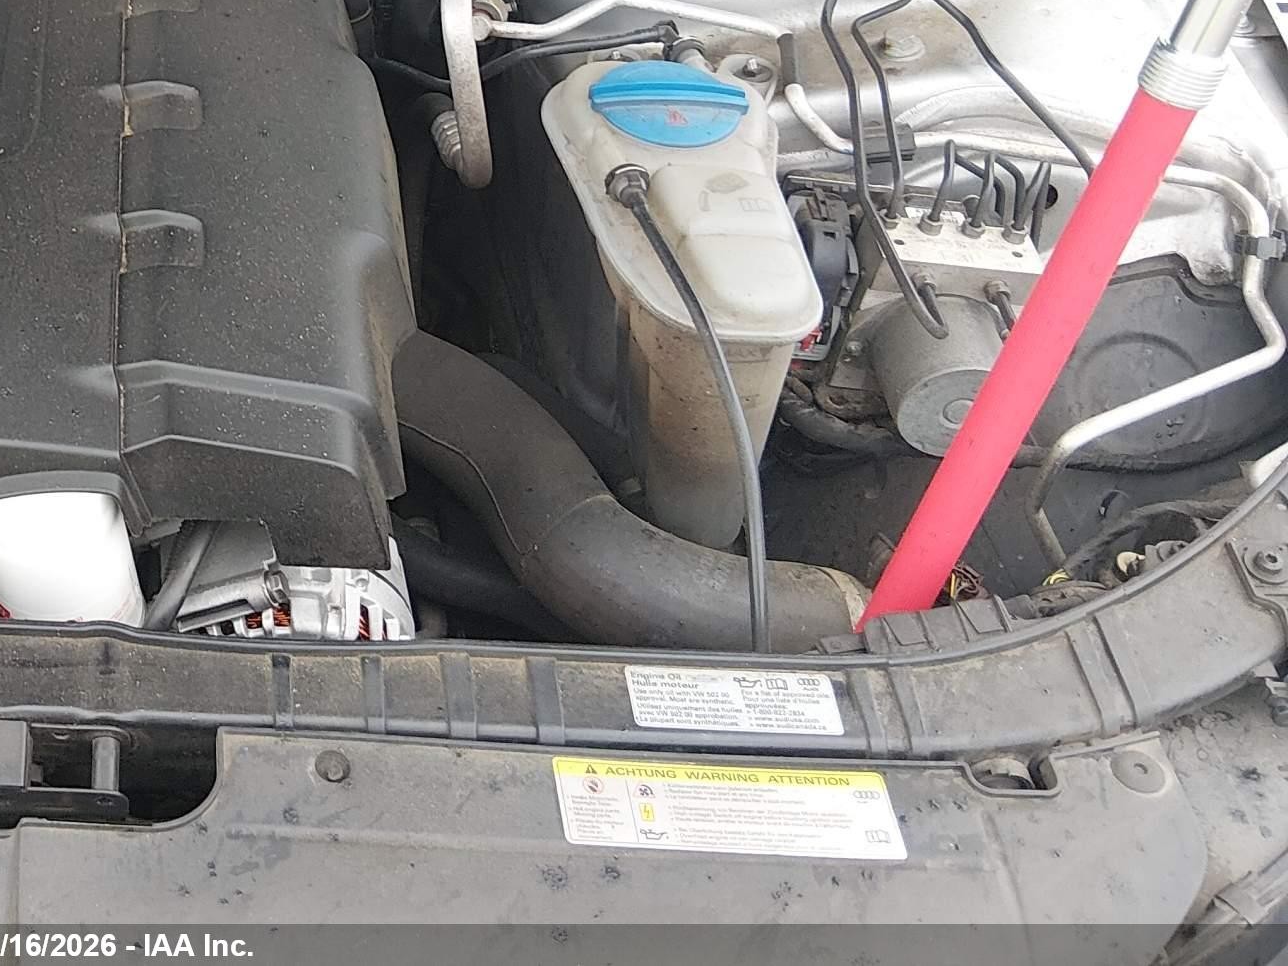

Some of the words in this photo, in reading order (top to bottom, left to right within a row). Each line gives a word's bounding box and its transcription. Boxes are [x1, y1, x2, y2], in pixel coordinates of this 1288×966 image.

[630, 671, 664, 681] Engine
[661, 681, 700, 689] moteur
[605, 766, 677, 780] ACHTUNG
[684, 770, 760, 783] WARNING
[768, 774, 850, 787] ATTENTION
